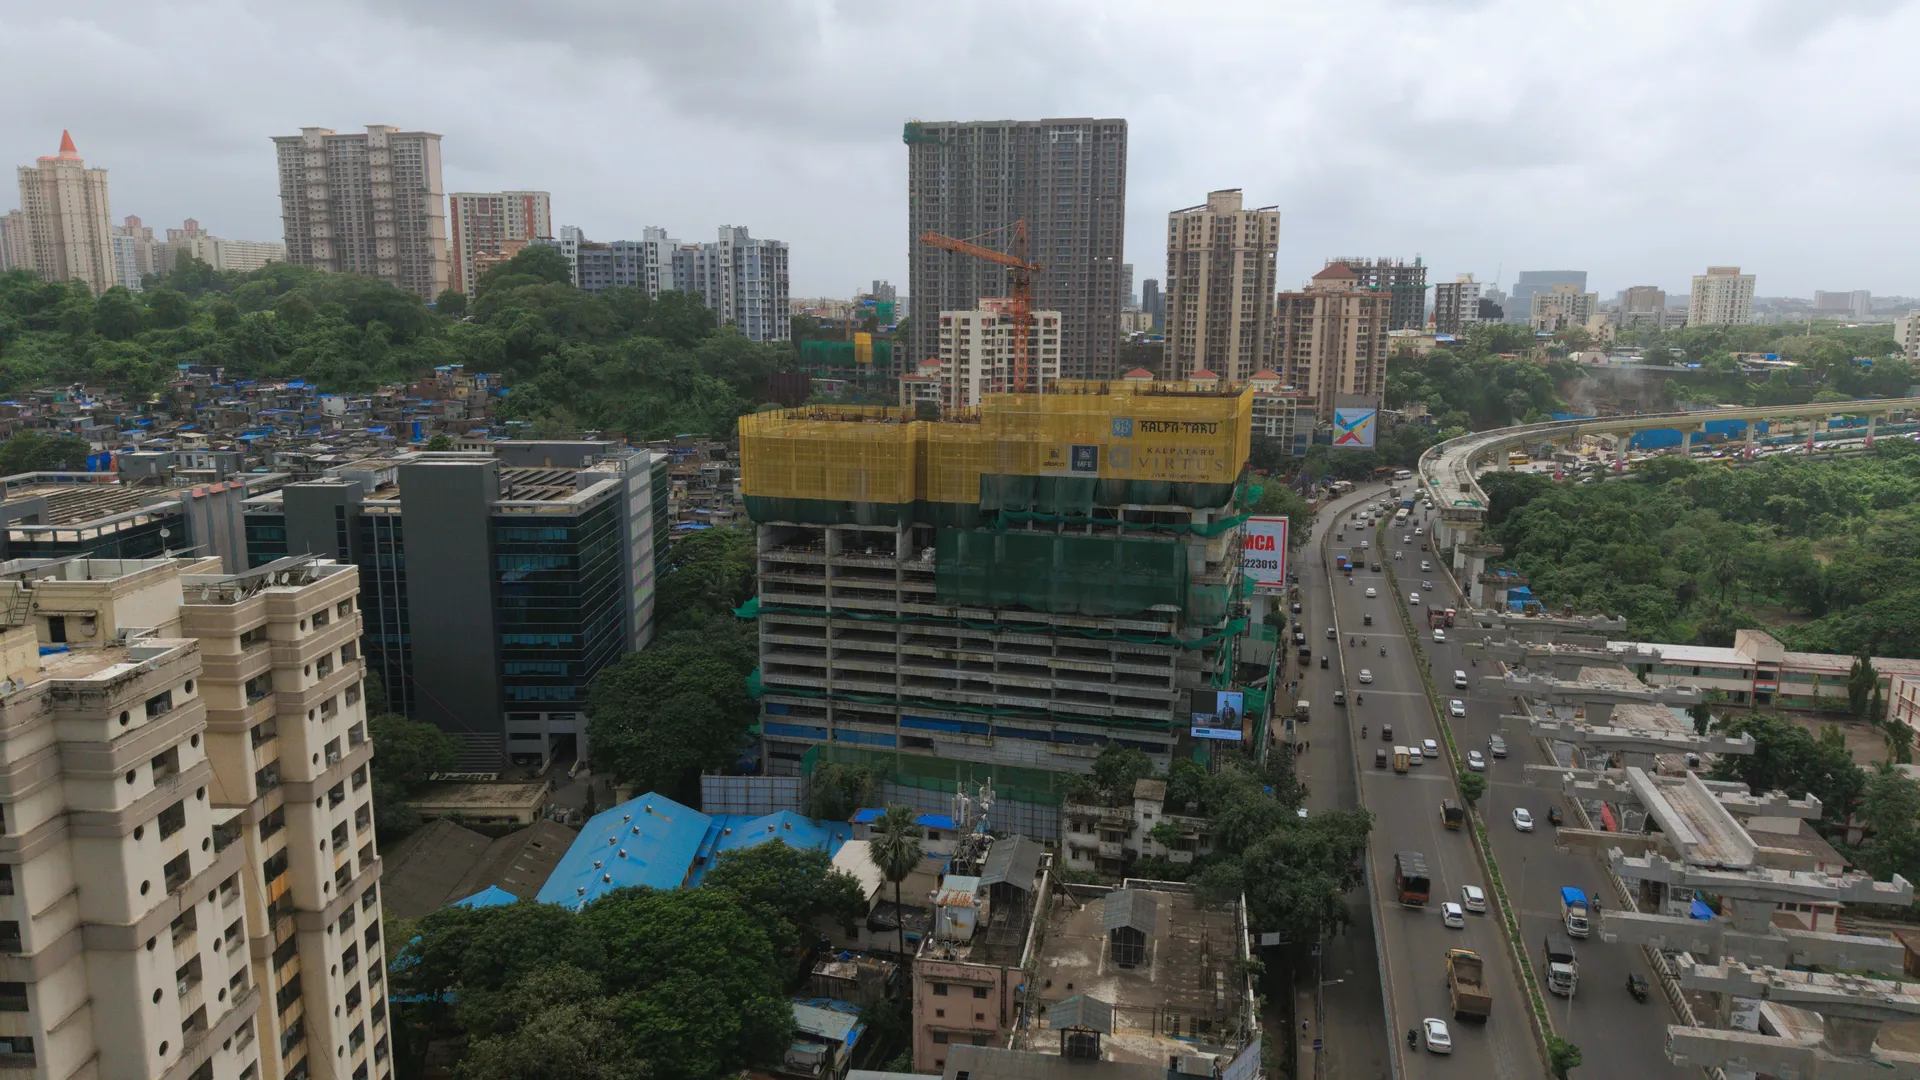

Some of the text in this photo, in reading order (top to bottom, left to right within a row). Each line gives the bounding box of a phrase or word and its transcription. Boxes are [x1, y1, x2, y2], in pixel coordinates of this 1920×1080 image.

[1147, 447, 1215, 456] KALPATARU
[1077, 460, 1092, 468] MFE
[1138, 457, 1223, 472] VIRTUS
